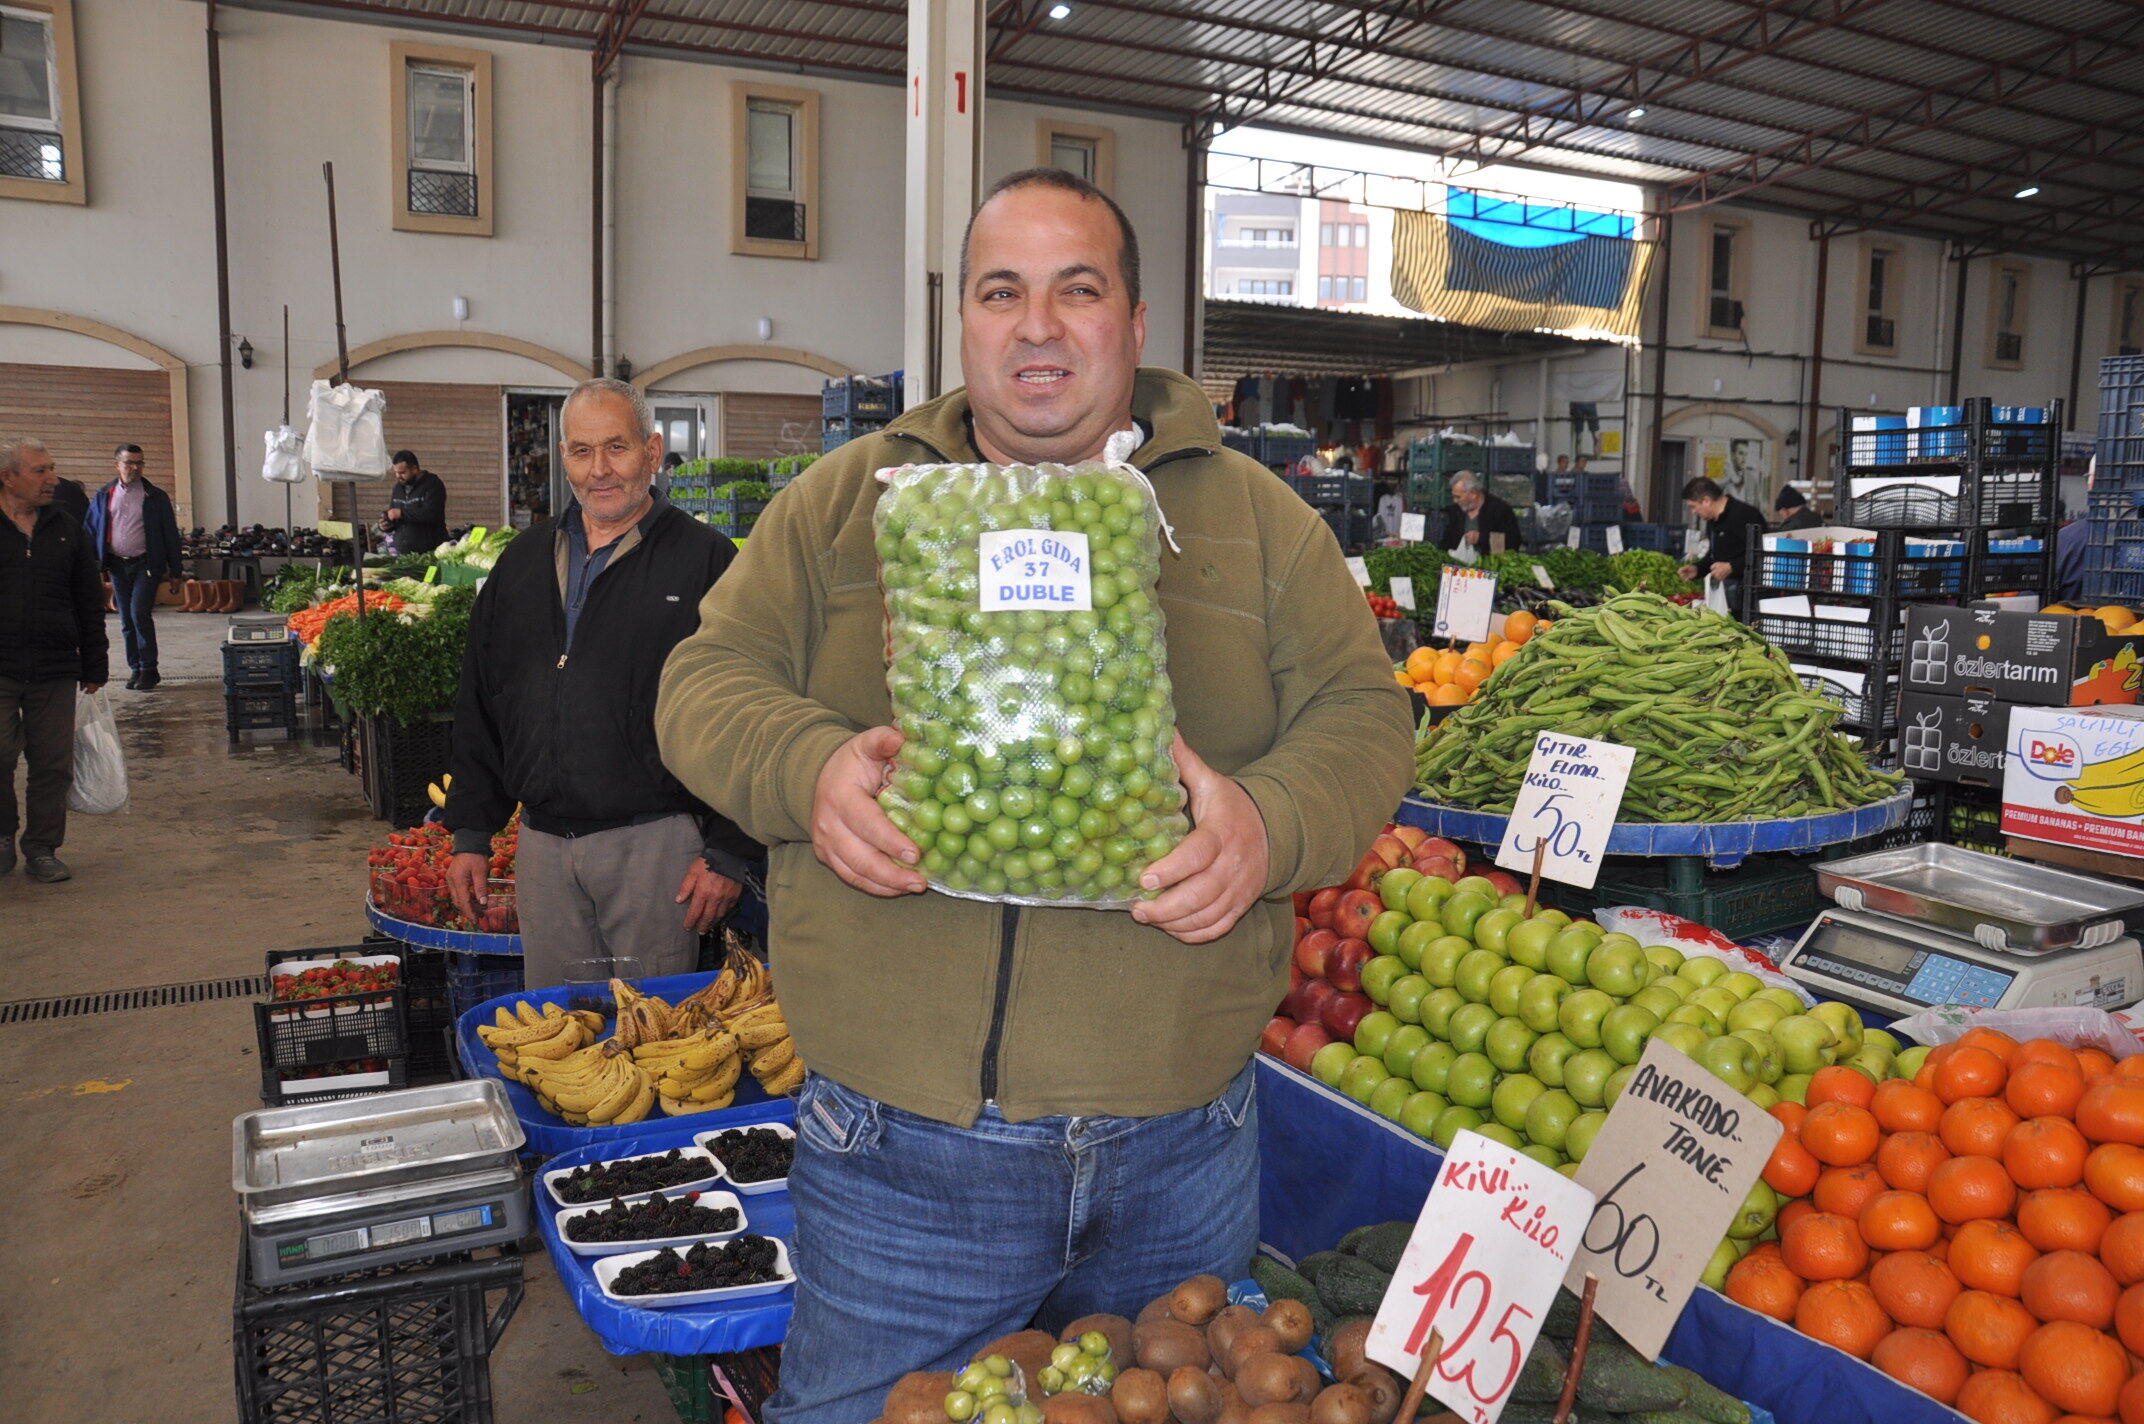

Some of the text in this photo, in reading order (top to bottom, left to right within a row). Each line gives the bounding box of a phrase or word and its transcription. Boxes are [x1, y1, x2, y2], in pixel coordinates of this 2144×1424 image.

[955, 71, 966, 114] 1
[1024, 562, 1050, 577] 37
[1041, 538, 1081, 574] GIDA
[999, 584, 1075, 602] DUBLE
[2030, 740, 2075, 764] Dole
[1514, 794, 1593, 863] 50 TL
[2004, 808, 2038, 824] PREMIUM
[2039, 814, 2078, 830] BANANAS
[2083, 822, 2126, 839] PREMIUM
[1581, 1162, 1669, 1303] 60 TL
[1403, 1232, 1534, 1405] 125
